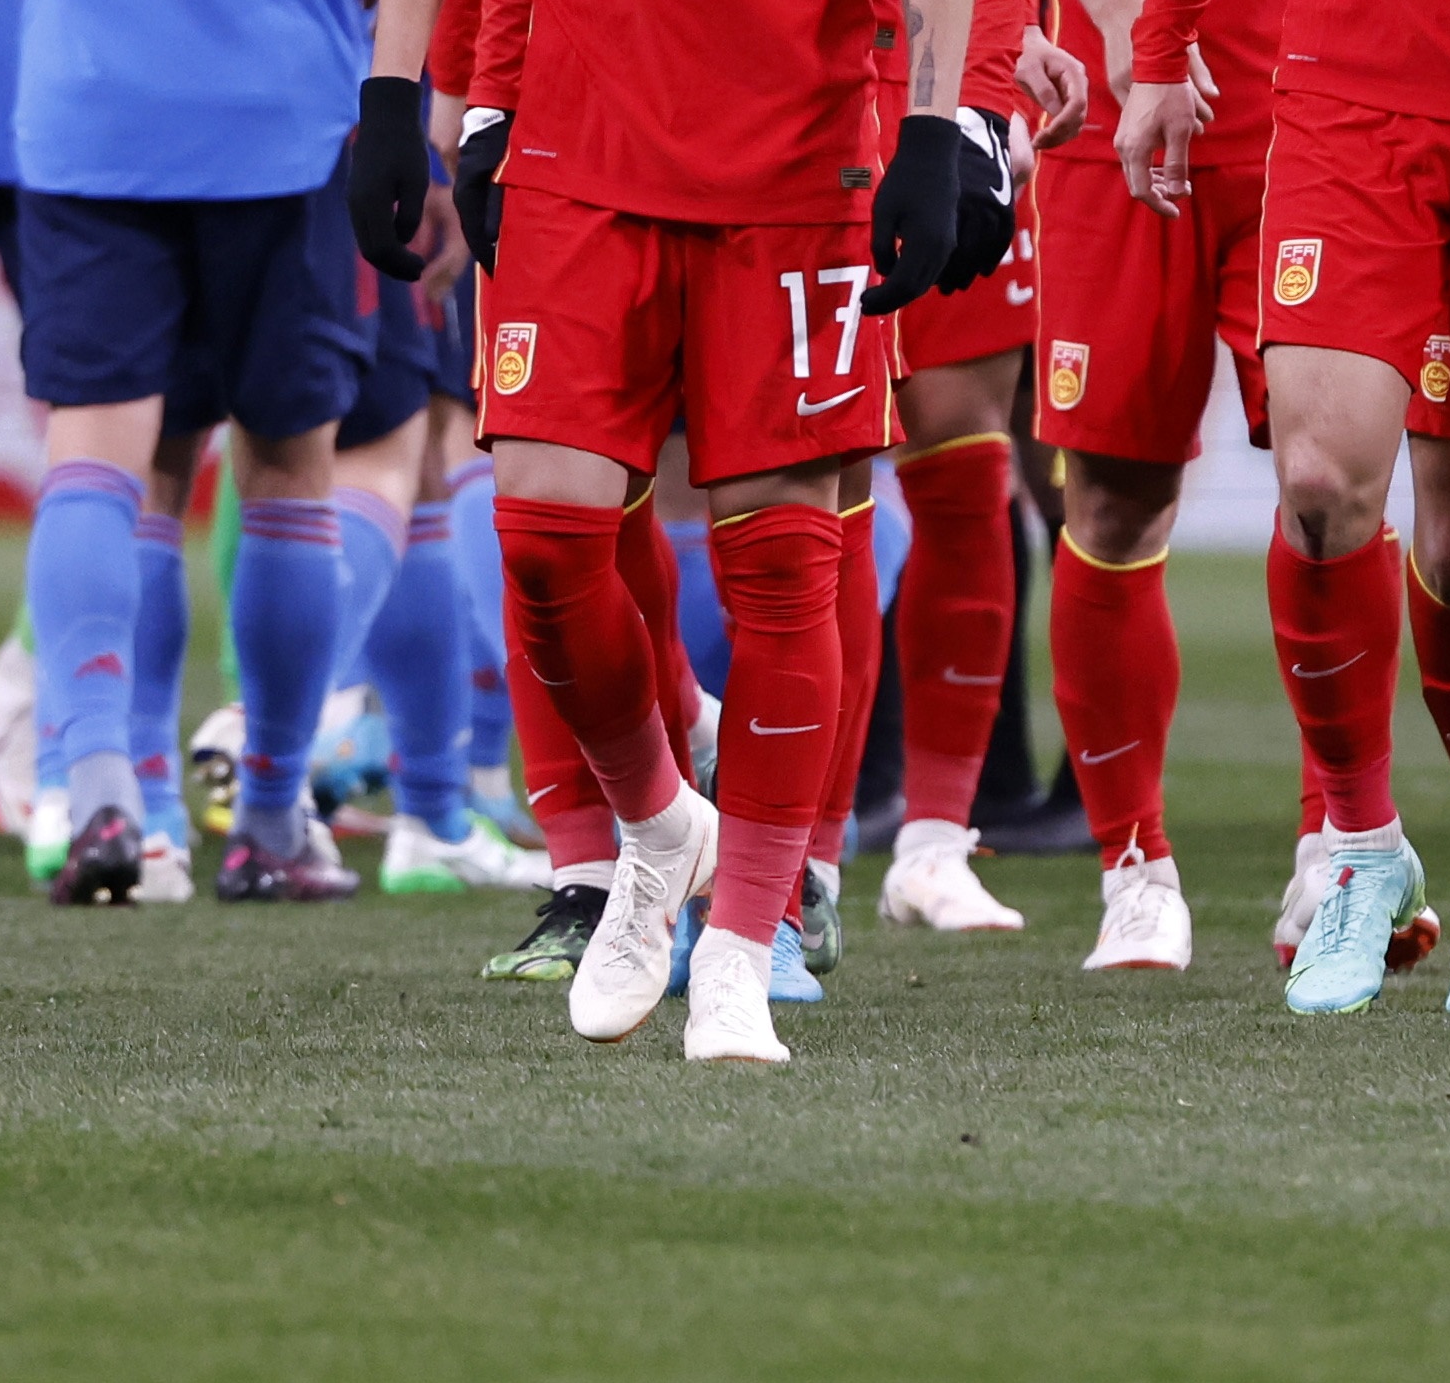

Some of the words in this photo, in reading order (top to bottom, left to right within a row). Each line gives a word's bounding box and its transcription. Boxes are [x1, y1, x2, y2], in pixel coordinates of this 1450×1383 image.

[1282, 245, 1316, 259] CFA
[780, 264, 871, 379] 17
[499, 329, 531, 344] CFA
